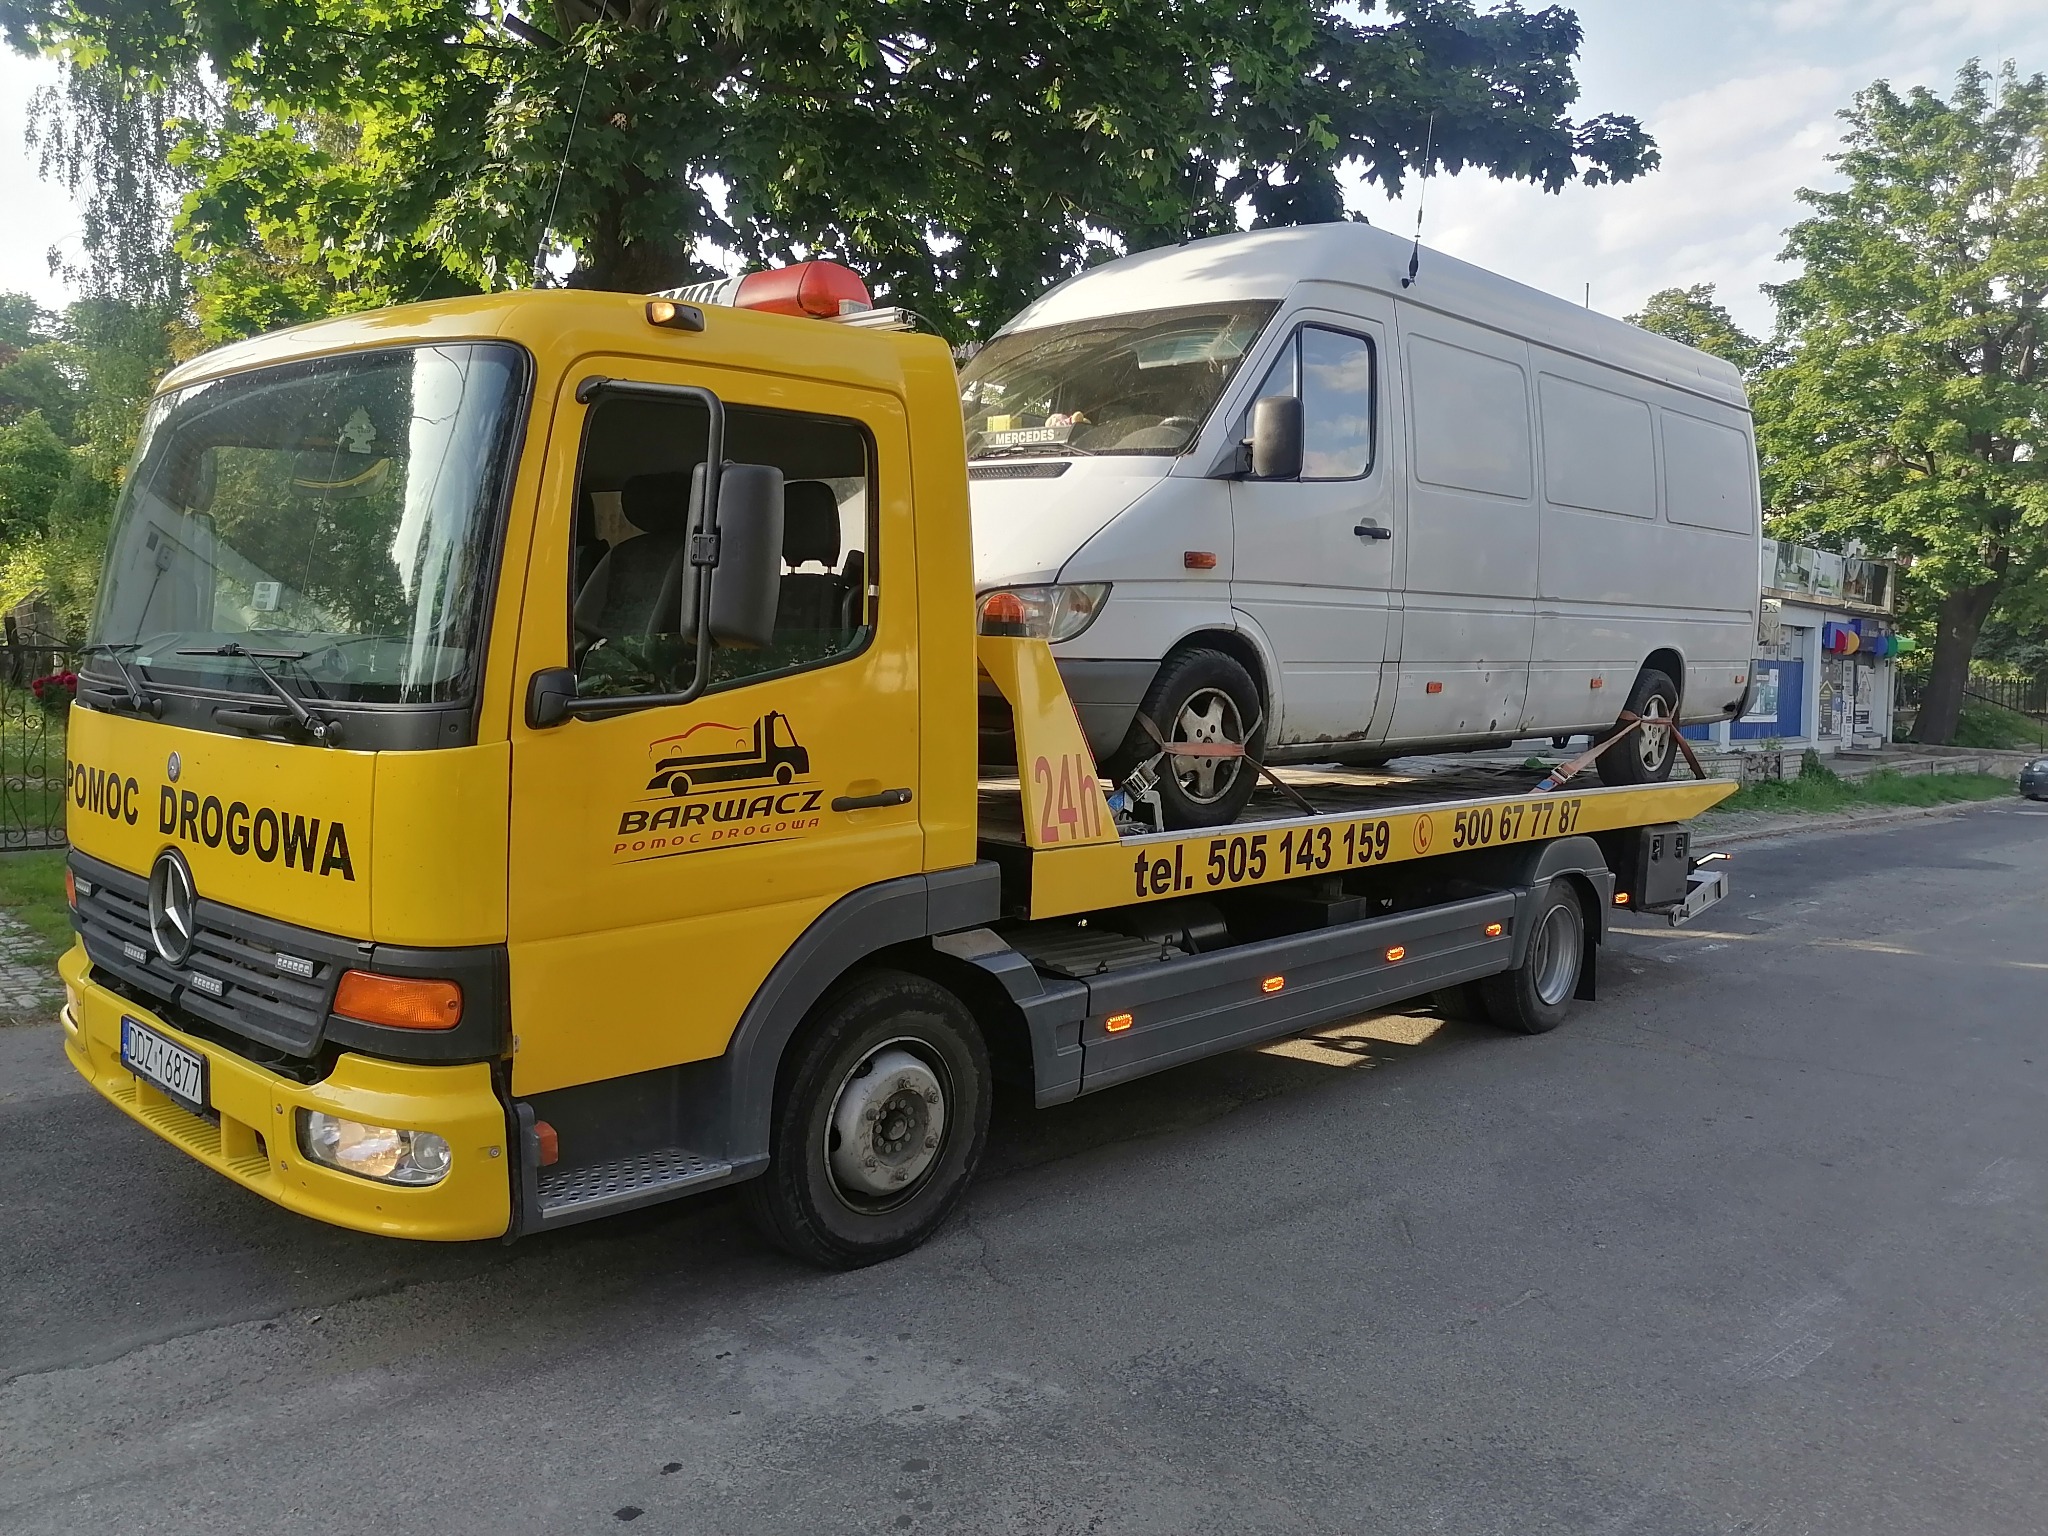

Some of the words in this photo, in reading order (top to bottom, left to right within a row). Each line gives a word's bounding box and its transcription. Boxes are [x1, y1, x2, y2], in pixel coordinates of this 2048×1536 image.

[995, 429, 1055, 445] MERCEDES
[67, 759, 140, 826] POMOC
[159, 784, 356, 882] DROGOWA
[617, 789, 825, 836] BARWACZ
[1034, 753, 1101, 844] 24h
[613, 833, 702, 854] POMOC
[711, 817, 820, 841] DROGOWA
[1133, 844, 1194, 898] tel.
[1206, 834, 1267, 886] 505
[1279, 828, 1332, 874] 143
[1343, 820, 1390, 865] 159
[1453, 807, 1494, 848] 500
[1499, 804, 1525, 842] 67
[1530, 801, 1555, 838] 77
[1558, 798, 1582, 834] 87
